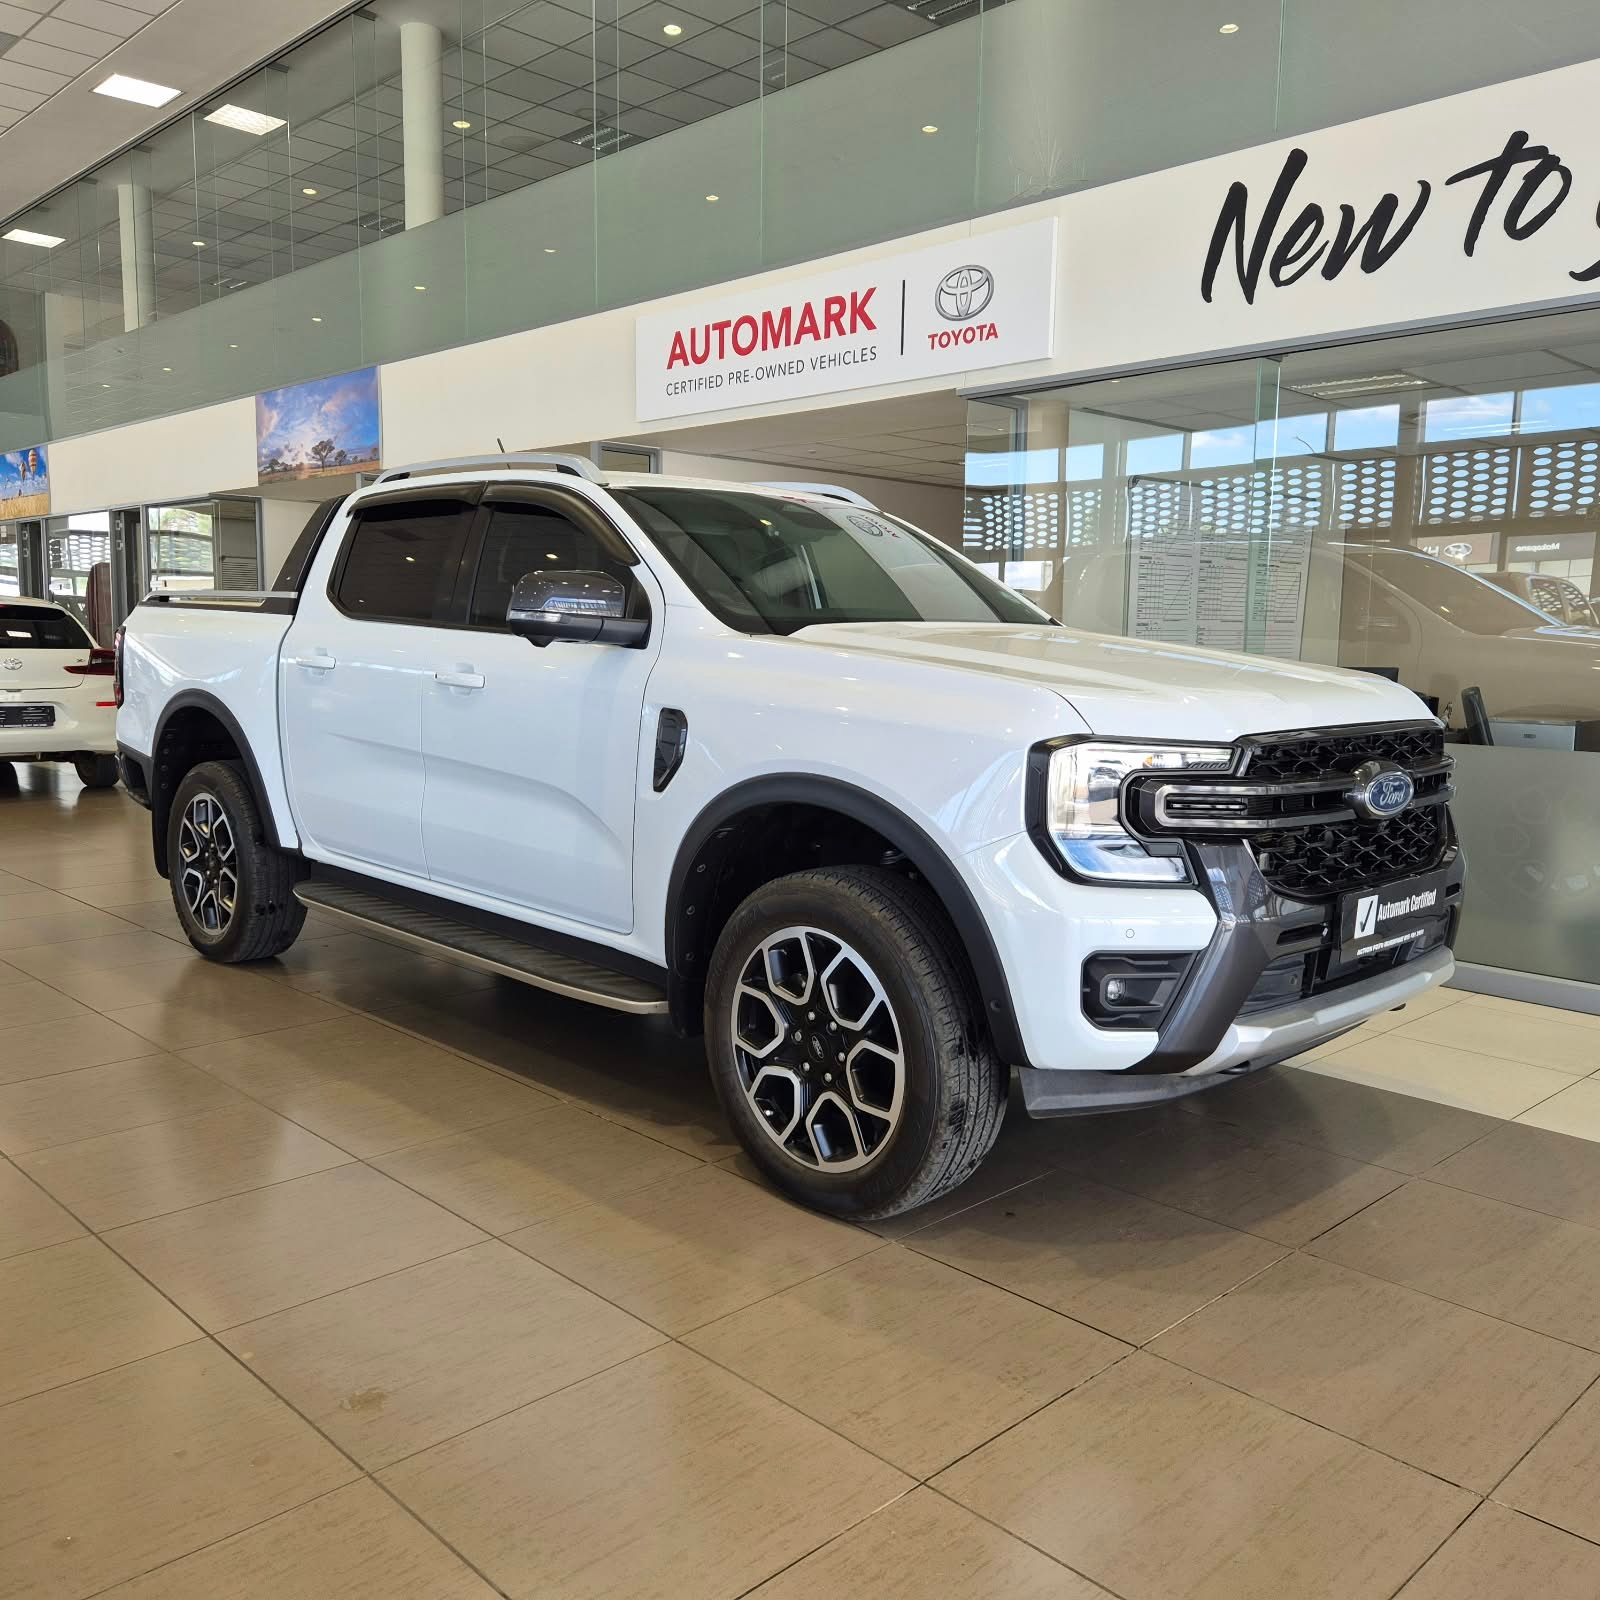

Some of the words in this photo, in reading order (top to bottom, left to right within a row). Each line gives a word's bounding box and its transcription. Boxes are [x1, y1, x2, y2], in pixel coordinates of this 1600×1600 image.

[1200, 148, 1432, 305] New
[666, 286, 878, 370] AUTOMARK
[928, 322, 999, 350] TOYOTA
[666, 374, 724, 396] CERTIFIED
[728, 359, 805, 386] PRE-OWNED
[810, 345, 878, 371] VEHICLES
[1379, 780, 1405, 806] Ford
[1377, 897, 1411, 921] Automark
[1411, 888, 1437, 911] Certified
